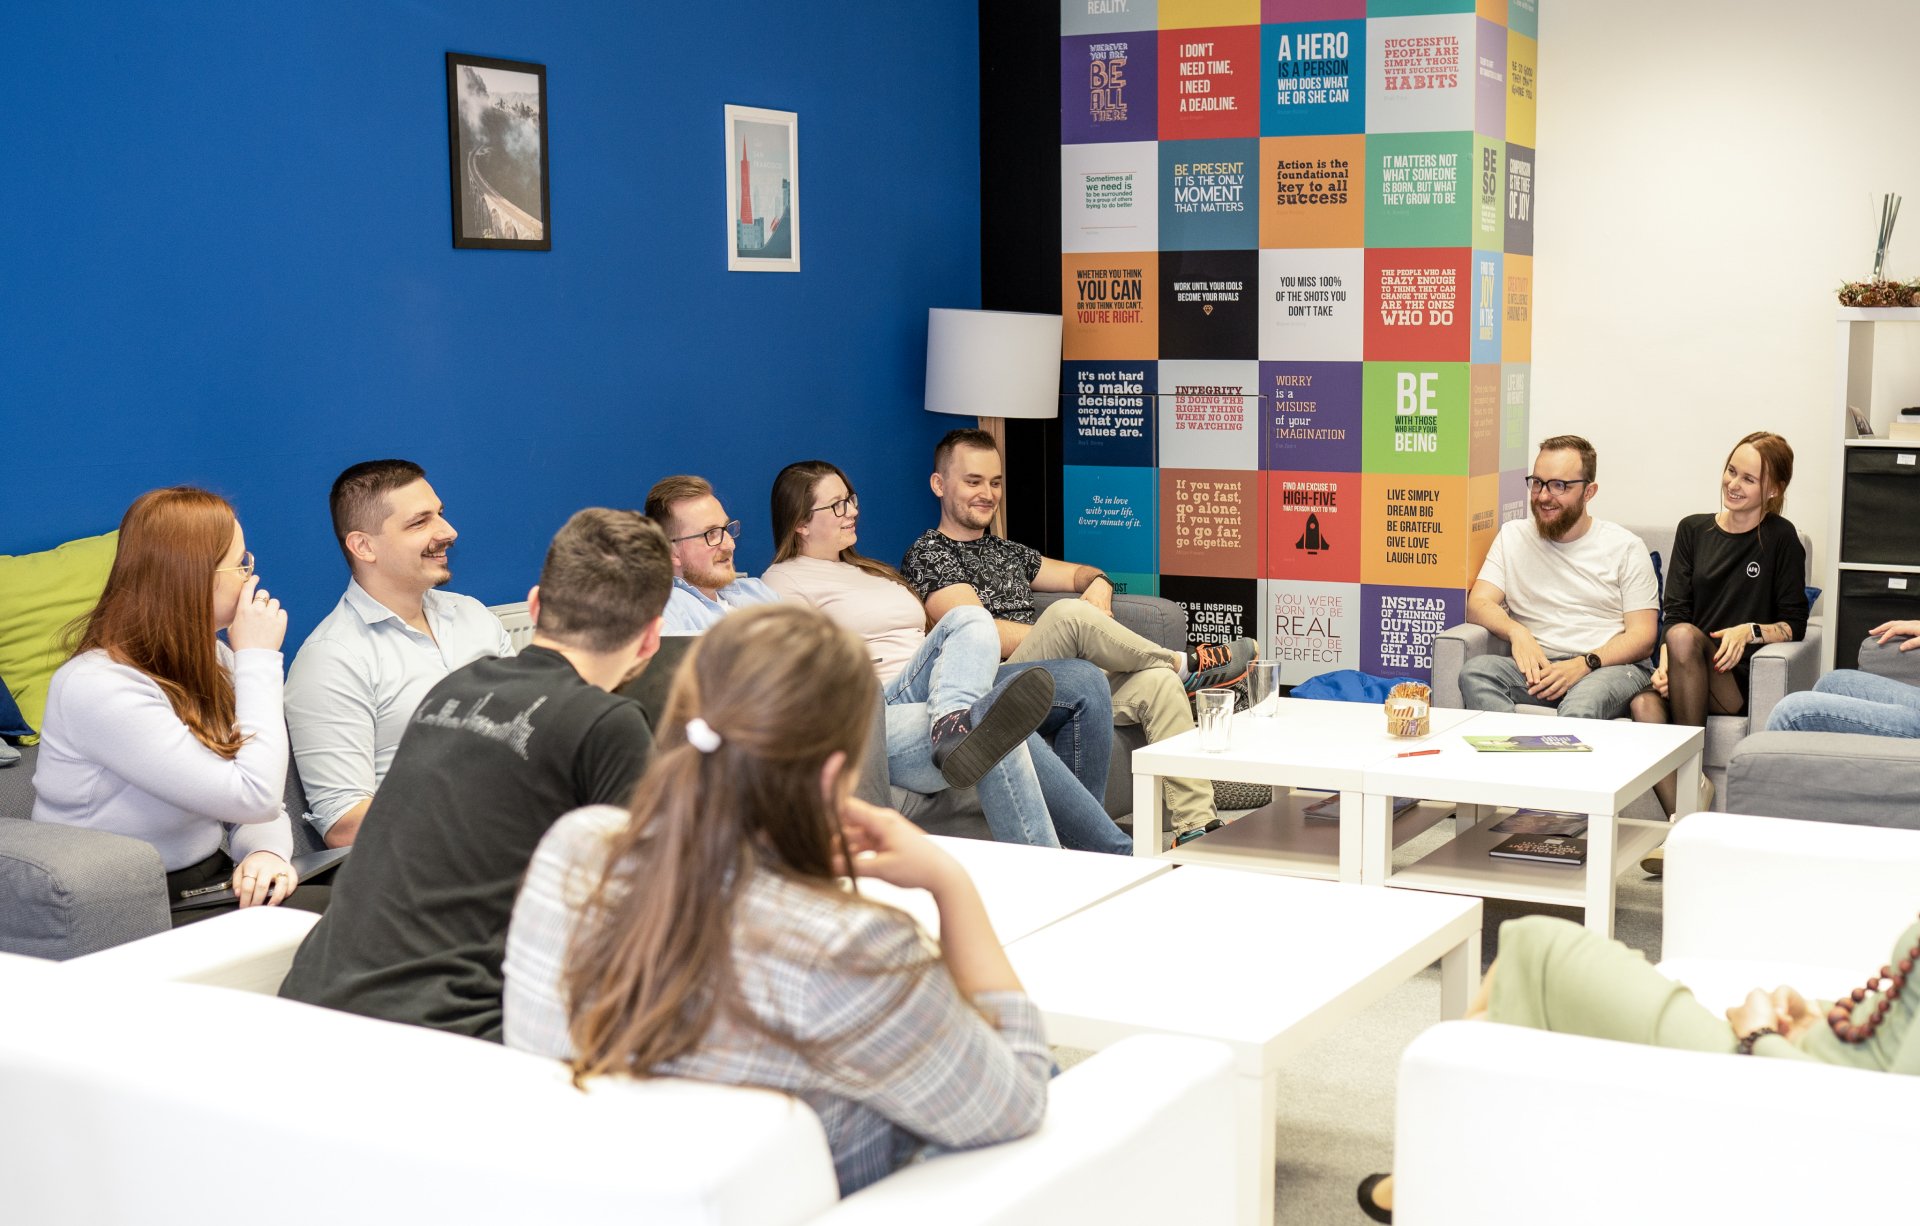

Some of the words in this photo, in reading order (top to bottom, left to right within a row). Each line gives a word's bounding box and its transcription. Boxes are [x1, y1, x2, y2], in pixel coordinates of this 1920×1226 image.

[1088, 0, 1129, 15] REALITY.
[1180, 45, 1183, 57] I
[1186, 43, 1214, 57] DON'T
[1278, 35, 1291, 61] A
[1297, 32, 1348, 60] HERO
[1090, 59, 1126, 89] BE
[1180, 62, 1204, 76] NEED
[1207, 60, 1233, 75] TIME,
[1279, 62, 1289, 77] IS
[1292, 61, 1299, 76] A
[1304, 60, 1348, 76] PERSON
[1180, 81, 1183, 94] I
[1186, 80, 1210, 93] NEED
[1278, 79, 1298, 90] WHO
[1300, 77, 1321, 89] DOES
[1324, 76, 1348, 88] WHAT
[1385, 74, 1457, 90] HABITS
[1278, 92, 1290, 104] HE
[1293, 91, 1305, 103] OR
[1308, 91, 1326, 103] SHE
[1329, 89, 1349, 102] CAN
[1180, 99, 1186, 112] A
[1189, 97, 1237, 112] DEADLINE.
[1277, 161, 1313, 169] Action
[1317, 160, 1326, 169] is
[1331, 159, 1348, 168] the
[1484, 148, 1496, 173] BE
[1175, 164, 1188, 175] BE
[1193, 162, 1243, 174] PRESENT
[1277, 169, 1349, 179] foundational
[1175, 177, 1181, 186] IT
[1186, 176, 1194, 186] IS
[1198, 176, 1214, 185] THE
[1219, 175, 1244, 185] ONLY
[1483, 172, 1495, 195] SO
[1175, 186, 1243, 202] MOMENT
[1278, 182, 1302, 196] key
[1310, 182, 1322, 192] to
[1329, 180, 1347, 191] all
[1278, 193, 1347, 205] success
[1175, 204, 1196, 213] THAT
[1201, 202, 1243, 212] MATTERS
[1078, 280, 1106, 300] YOU
[1111, 280, 1141, 300] CAN
[1174, 282, 1191, 291] WORK
[1192, 282, 1208, 290] UNTIL
[1210, 282, 1224, 290] YOUR
[1226, 282, 1242, 290] IDOLS
[1178, 293, 1201, 301] BECOME
[1202, 293, 1217, 301] YOUR
[1219, 293, 1238, 301] RIVALS
[1077, 311, 1110, 323] YOU'RE
[1113, 311, 1142, 323] RIGHT.
[1381, 311, 1422, 325] WHO
[1429, 311, 1453, 325] DO
[1078, 371, 1094, 380] It's
[1098, 372, 1115, 380] not
[1119, 371, 1144, 380] hard
[1276, 376, 1312, 386] WORRY
[1078, 382, 1094, 394] to
[1100, 381, 1142, 394] make
[1176, 386, 1243, 395] INTEGRITY
[1276, 389, 1284, 398] is
[1397, 372, 1438, 415] BE
[1078, 396, 1143, 406] decisions
[1276, 402, 1316, 412] MISUSE
[1100, 408, 1116, 416] you
[1078, 416, 1111, 426] what
[1114, 417, 1144, 428] your
[1276, 415, 1284, 425] of
[1289, 417, 1311, 427] your
[1395, 416, 1412, 425] WITH
[1415, 416, 1437, 425] THOSE
[1078, 427, 1116, 436] values
[1120, 428, 1142, 437] are.
[1276, 429, 1345, 439] IMAGINATION
[1395, 433, 1437, 452] BEING
[1093, 496, 1103, 504] Be
[1114, 496, 1128, 504] love
[1283, 492, 1336, 506] HIGH-FIVE
[1387, 490, 1405, 500] LIVE
[1408, 490, 1439, 501] SIMPLY
[1086, 507, 1102, 515] with
[1103, 508, 1119, 517] your
[1387, 505, 1417, 517] DREAM
[1420, 506, 1433, 517] BIG
[1078, 517, 1098, 527] Every
[1100, 518, 1124, 526] minute
[1125, 518, 1133, 529] of
[1387, 521, 1397, 532] BE
[1400, 522, 1442, 533] GRATEFUL
[1176, 538, 1190, 548] go
[1193, 538, 1241, 549] together.
[1387, 537, 1405, 548] GIVE
[1408, 537, 1429, 549] LOVE
[1387, 552, 1413, 564] LAUGH
[1417, 553, 1437, 565] LOTS
[1275, 594, 1302, 605] YOU
[1307, 595, 1342, 607] WERE
[1382, 596, 1445, 610] INSTEAD
[1190, 602, 1200, 610] BE
[1204, 604, 1243, 612] INSPIRED
[1275, 605, 1305, 615] BORN
[1312, 607, 1325, 616] TO
[1331, 608, 1343, 617] BE
[1195, 612, 1242, 625] GREAT
[1381, 609, 1393, 617] OF
[1397, 610, 1445, 620] THINKING
[1192, 624, 1230, 633] INSPIRE
[1234, 625, 1243, 634] IS
[1276, 615, 1340, 638] REAL
[1381, 618, 1444, 633] OUTSIDE
[1185, 633, 1242, 643] CREDIBL
[1275, 636, 1300, 647] NOT
[1307, 638, 1322, 648] TO
[1328, 639, 1342, 649] BE
[1381, 632, 1407, 644] THE
[1276, 647, 1342, 663] PERFECT
[1381, 644, 1404, 654] GET
[1407, 646, 1427, 655] RID
[1381, 654, 1408, 667] THE
[1414, 656, 1432, 669] BO
